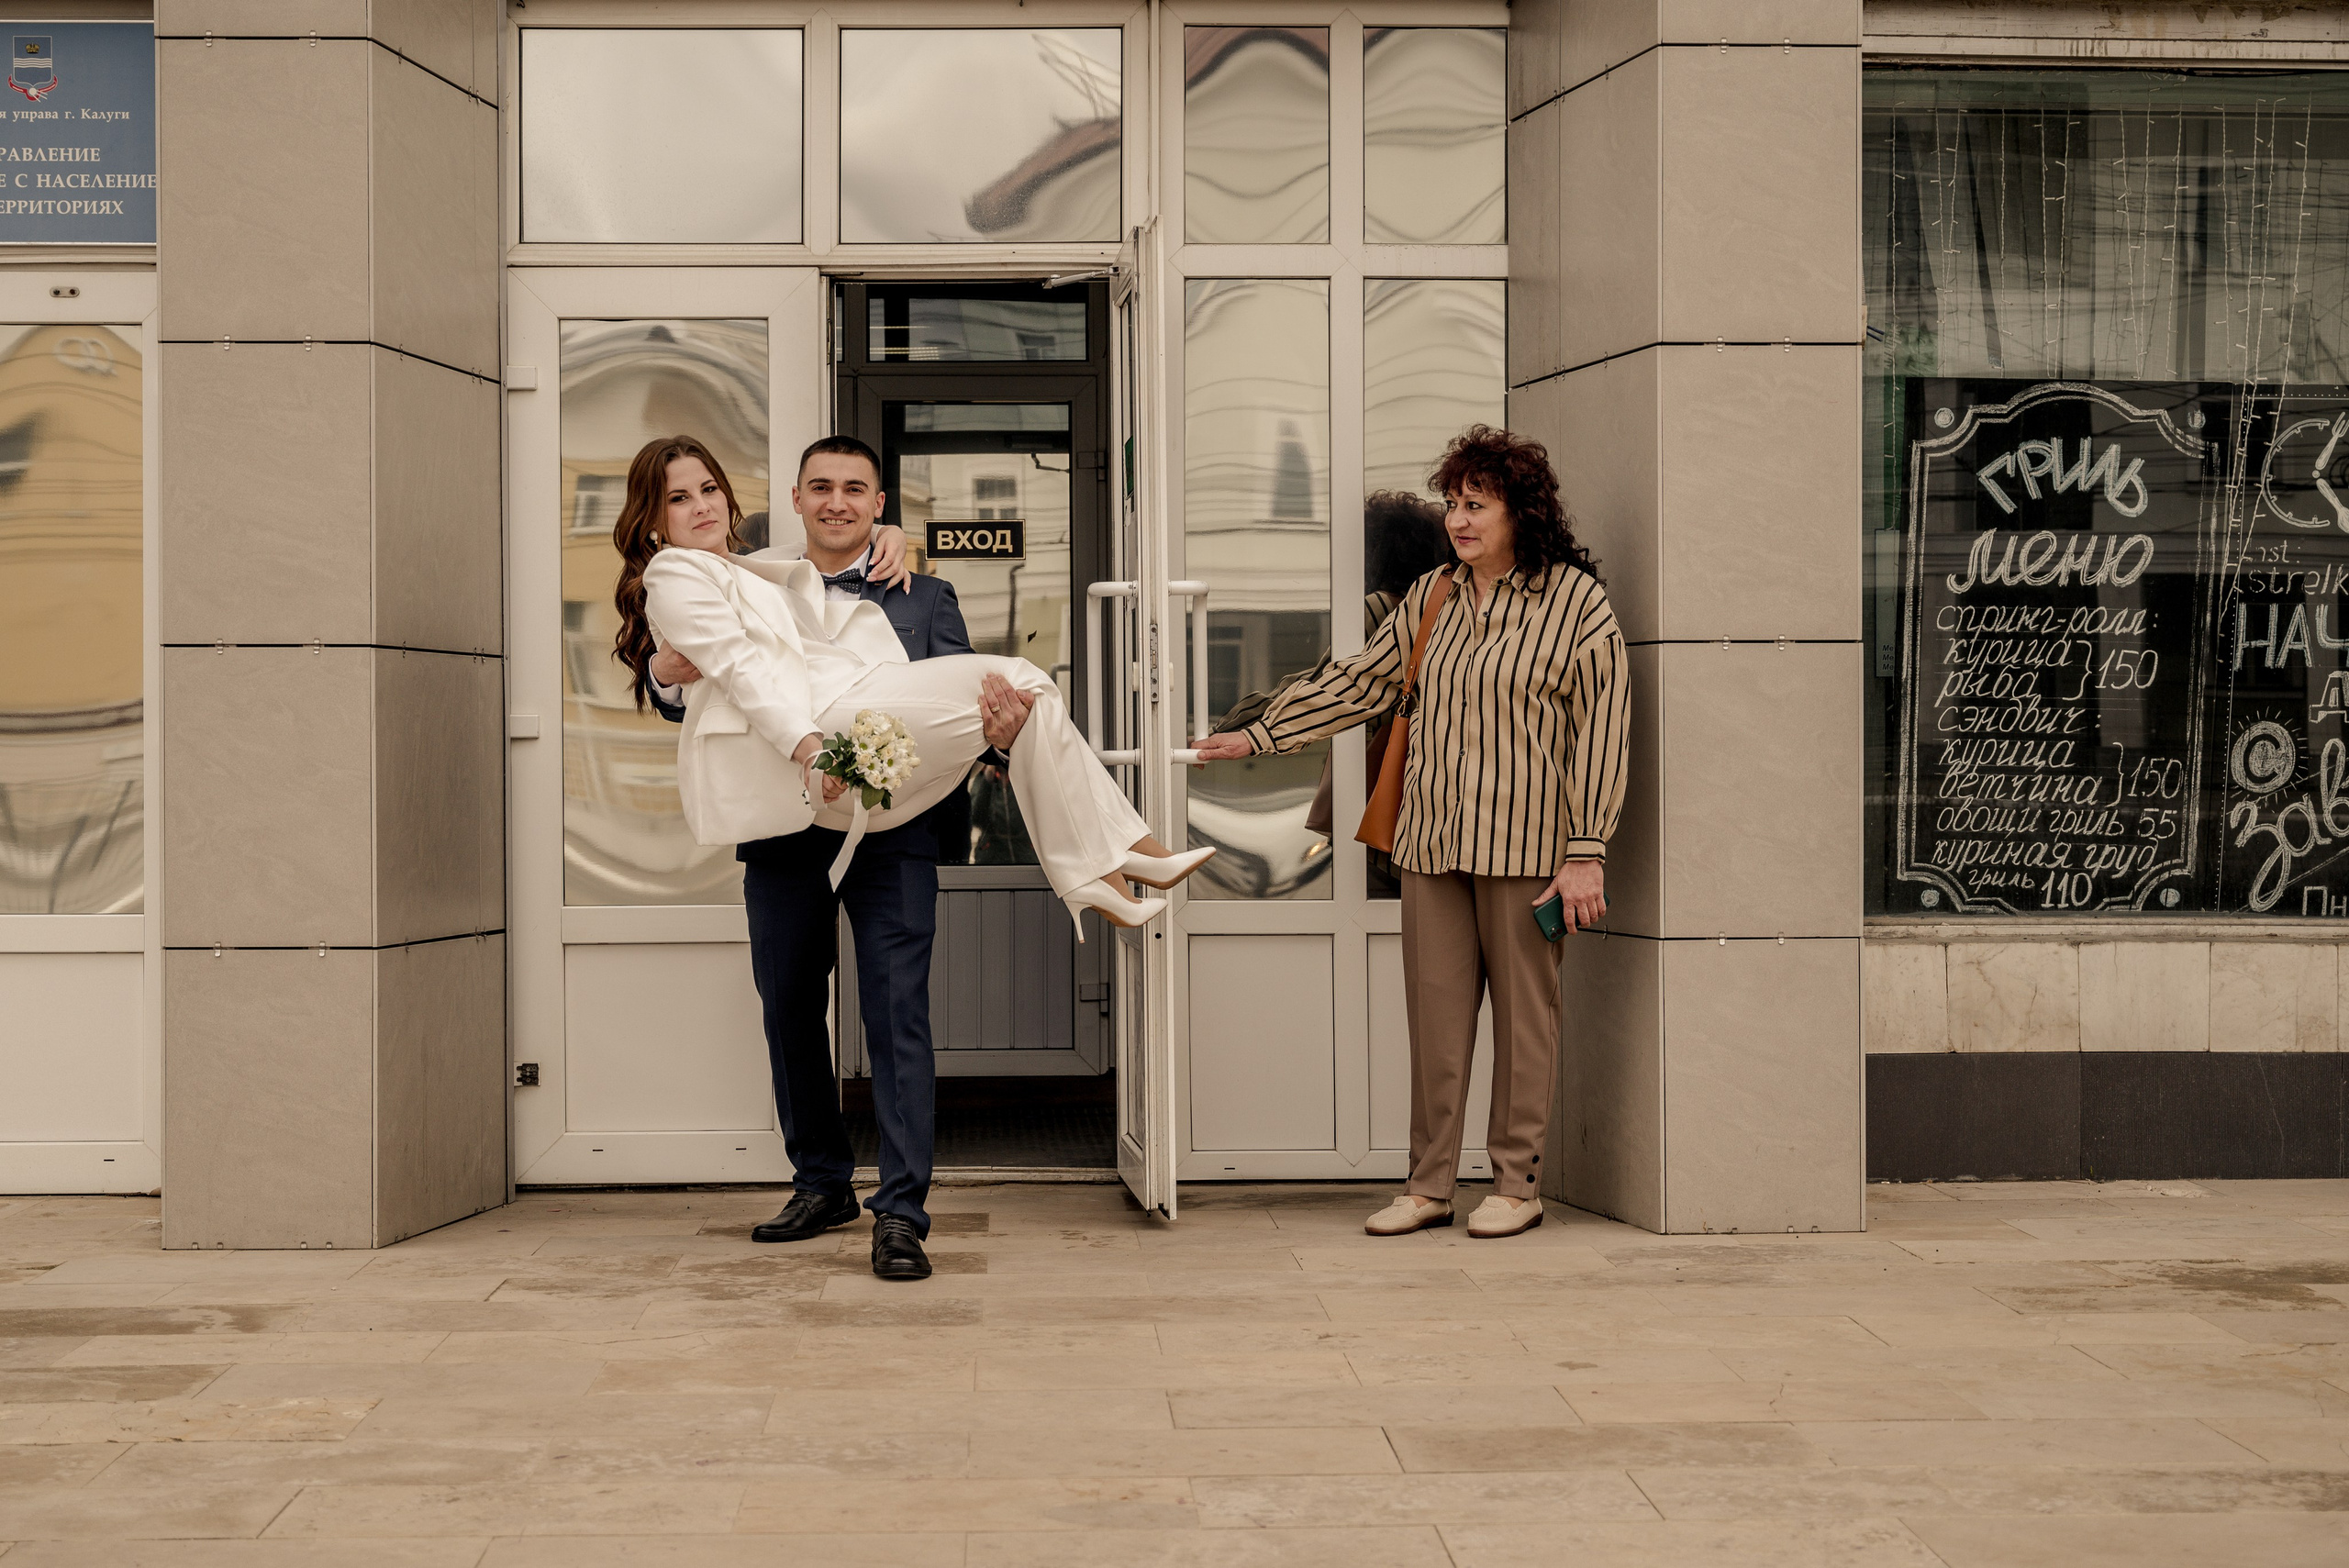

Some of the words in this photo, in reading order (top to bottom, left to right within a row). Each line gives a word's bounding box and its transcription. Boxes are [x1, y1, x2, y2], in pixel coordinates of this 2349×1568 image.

[12, 111, 59, 122] управа
[64, 111, 75, 119] г.
[81, 108, 129, 122] Калуги
[0, 148, 101, 161] РАВЛЕНИЕ
[15, 173, 28, 188] С
[36, 173, 156, 188] НАСЕЛЕНИЕ
[937, 529, 1013, 552] ВХОД
[1943, 638, 2073, 674] курица
[2094, 648, 2159, 690] 150
[1934, 665, 2040, 708] рыба
[1939, 738, 2076, 780] курица
[2127, 756, 2184, 799] 150
[1939, 762, 2103, 806] ветчина
[1936, 796, 2043, 839] овощи
[2048, 808, 2125, 842] гриль
[2137, 807, 2178, 839] 55
[1932, 839, 2074, 873] куриная
[1968, 868, 2036, 894] гриль
[2041, 871, 2093, 908] 110
